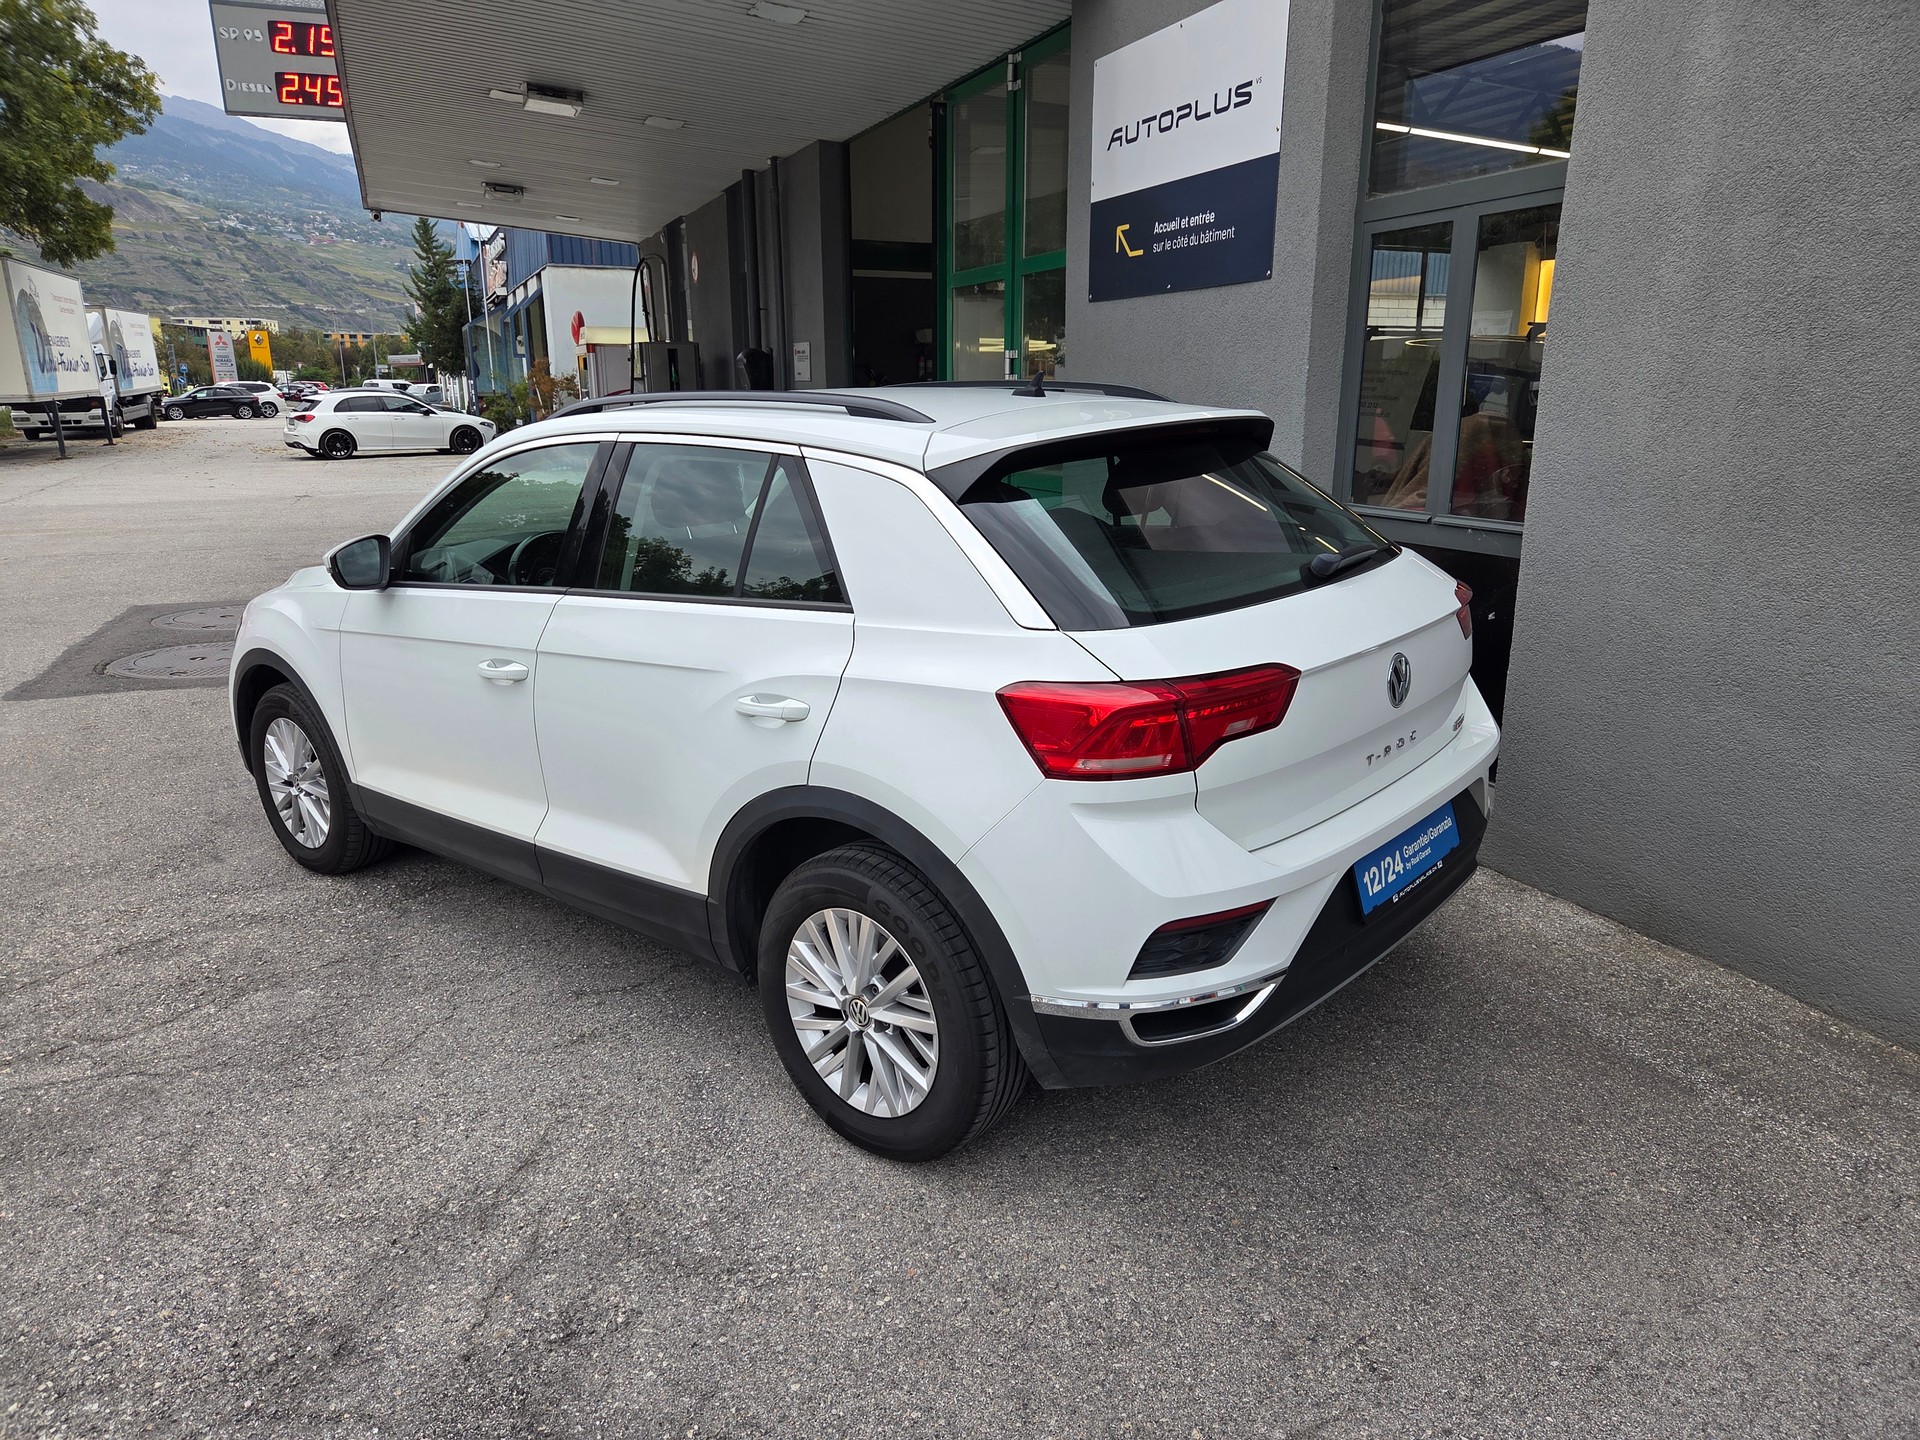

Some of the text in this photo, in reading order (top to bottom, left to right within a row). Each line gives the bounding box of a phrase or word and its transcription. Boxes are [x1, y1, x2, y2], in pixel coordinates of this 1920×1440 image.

[219, 26, 240, 40] SP
[281, 73, 343, 107] 2.45
[1107, 80, 1253, 151] AUTOPLUS
[1153, 226, 1236, 253] sur le côté du bâtiment
[1154, 210, 1215, 235] Accueil et entrée
[1366, 730, 1416, 766] T-ROC
[1403, 815, 1453, 858] Garantie/Garanzia
[1363, 850, 1404, 896] 12/24
[1405, 861, 1412, 870] by
